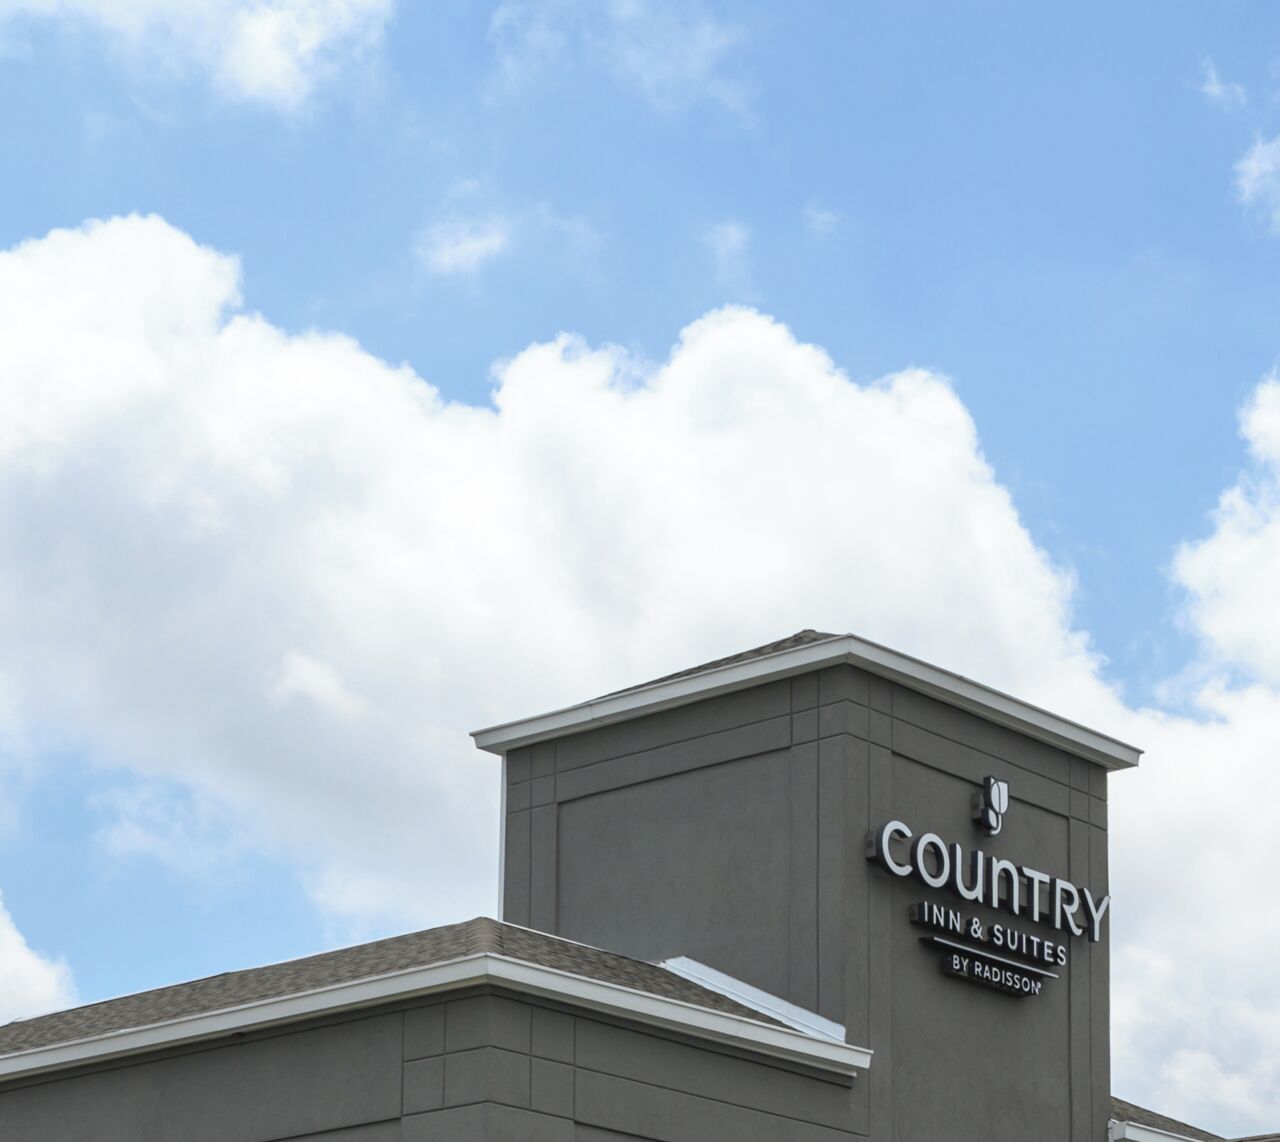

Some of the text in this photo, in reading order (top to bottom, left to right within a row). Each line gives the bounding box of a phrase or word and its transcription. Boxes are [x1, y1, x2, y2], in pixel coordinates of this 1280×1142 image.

[924, 900, 1067, 966] INN & SUITES
[952, 954, 969, 972] BY
